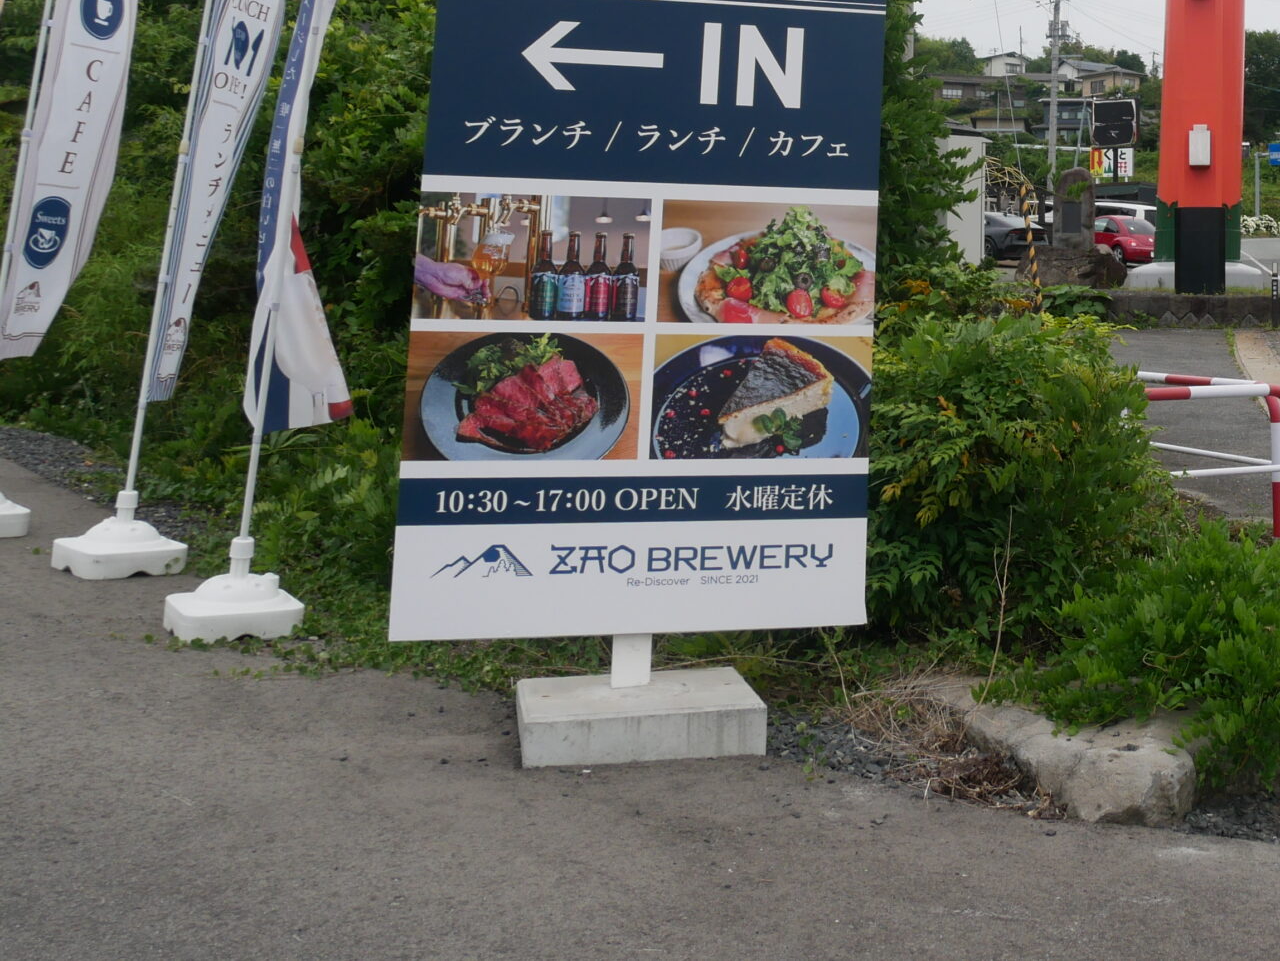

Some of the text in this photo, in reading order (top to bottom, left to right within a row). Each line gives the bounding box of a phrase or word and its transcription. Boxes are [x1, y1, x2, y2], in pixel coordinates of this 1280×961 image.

[700, 22, 805, 110] IN
[464, 116, 592, 150] ブランチ
[637, 124, 726, 154] ランチ
[768, 130, 849, 158] カフェ
[614, 488, 700, 512] OPEN
[725, 484, 834, 512] 水曜定休
[548, 543, 834, 575] ZAO BREWERY
[626, 574, 760, 588] Re-Discover SINCE 2021
